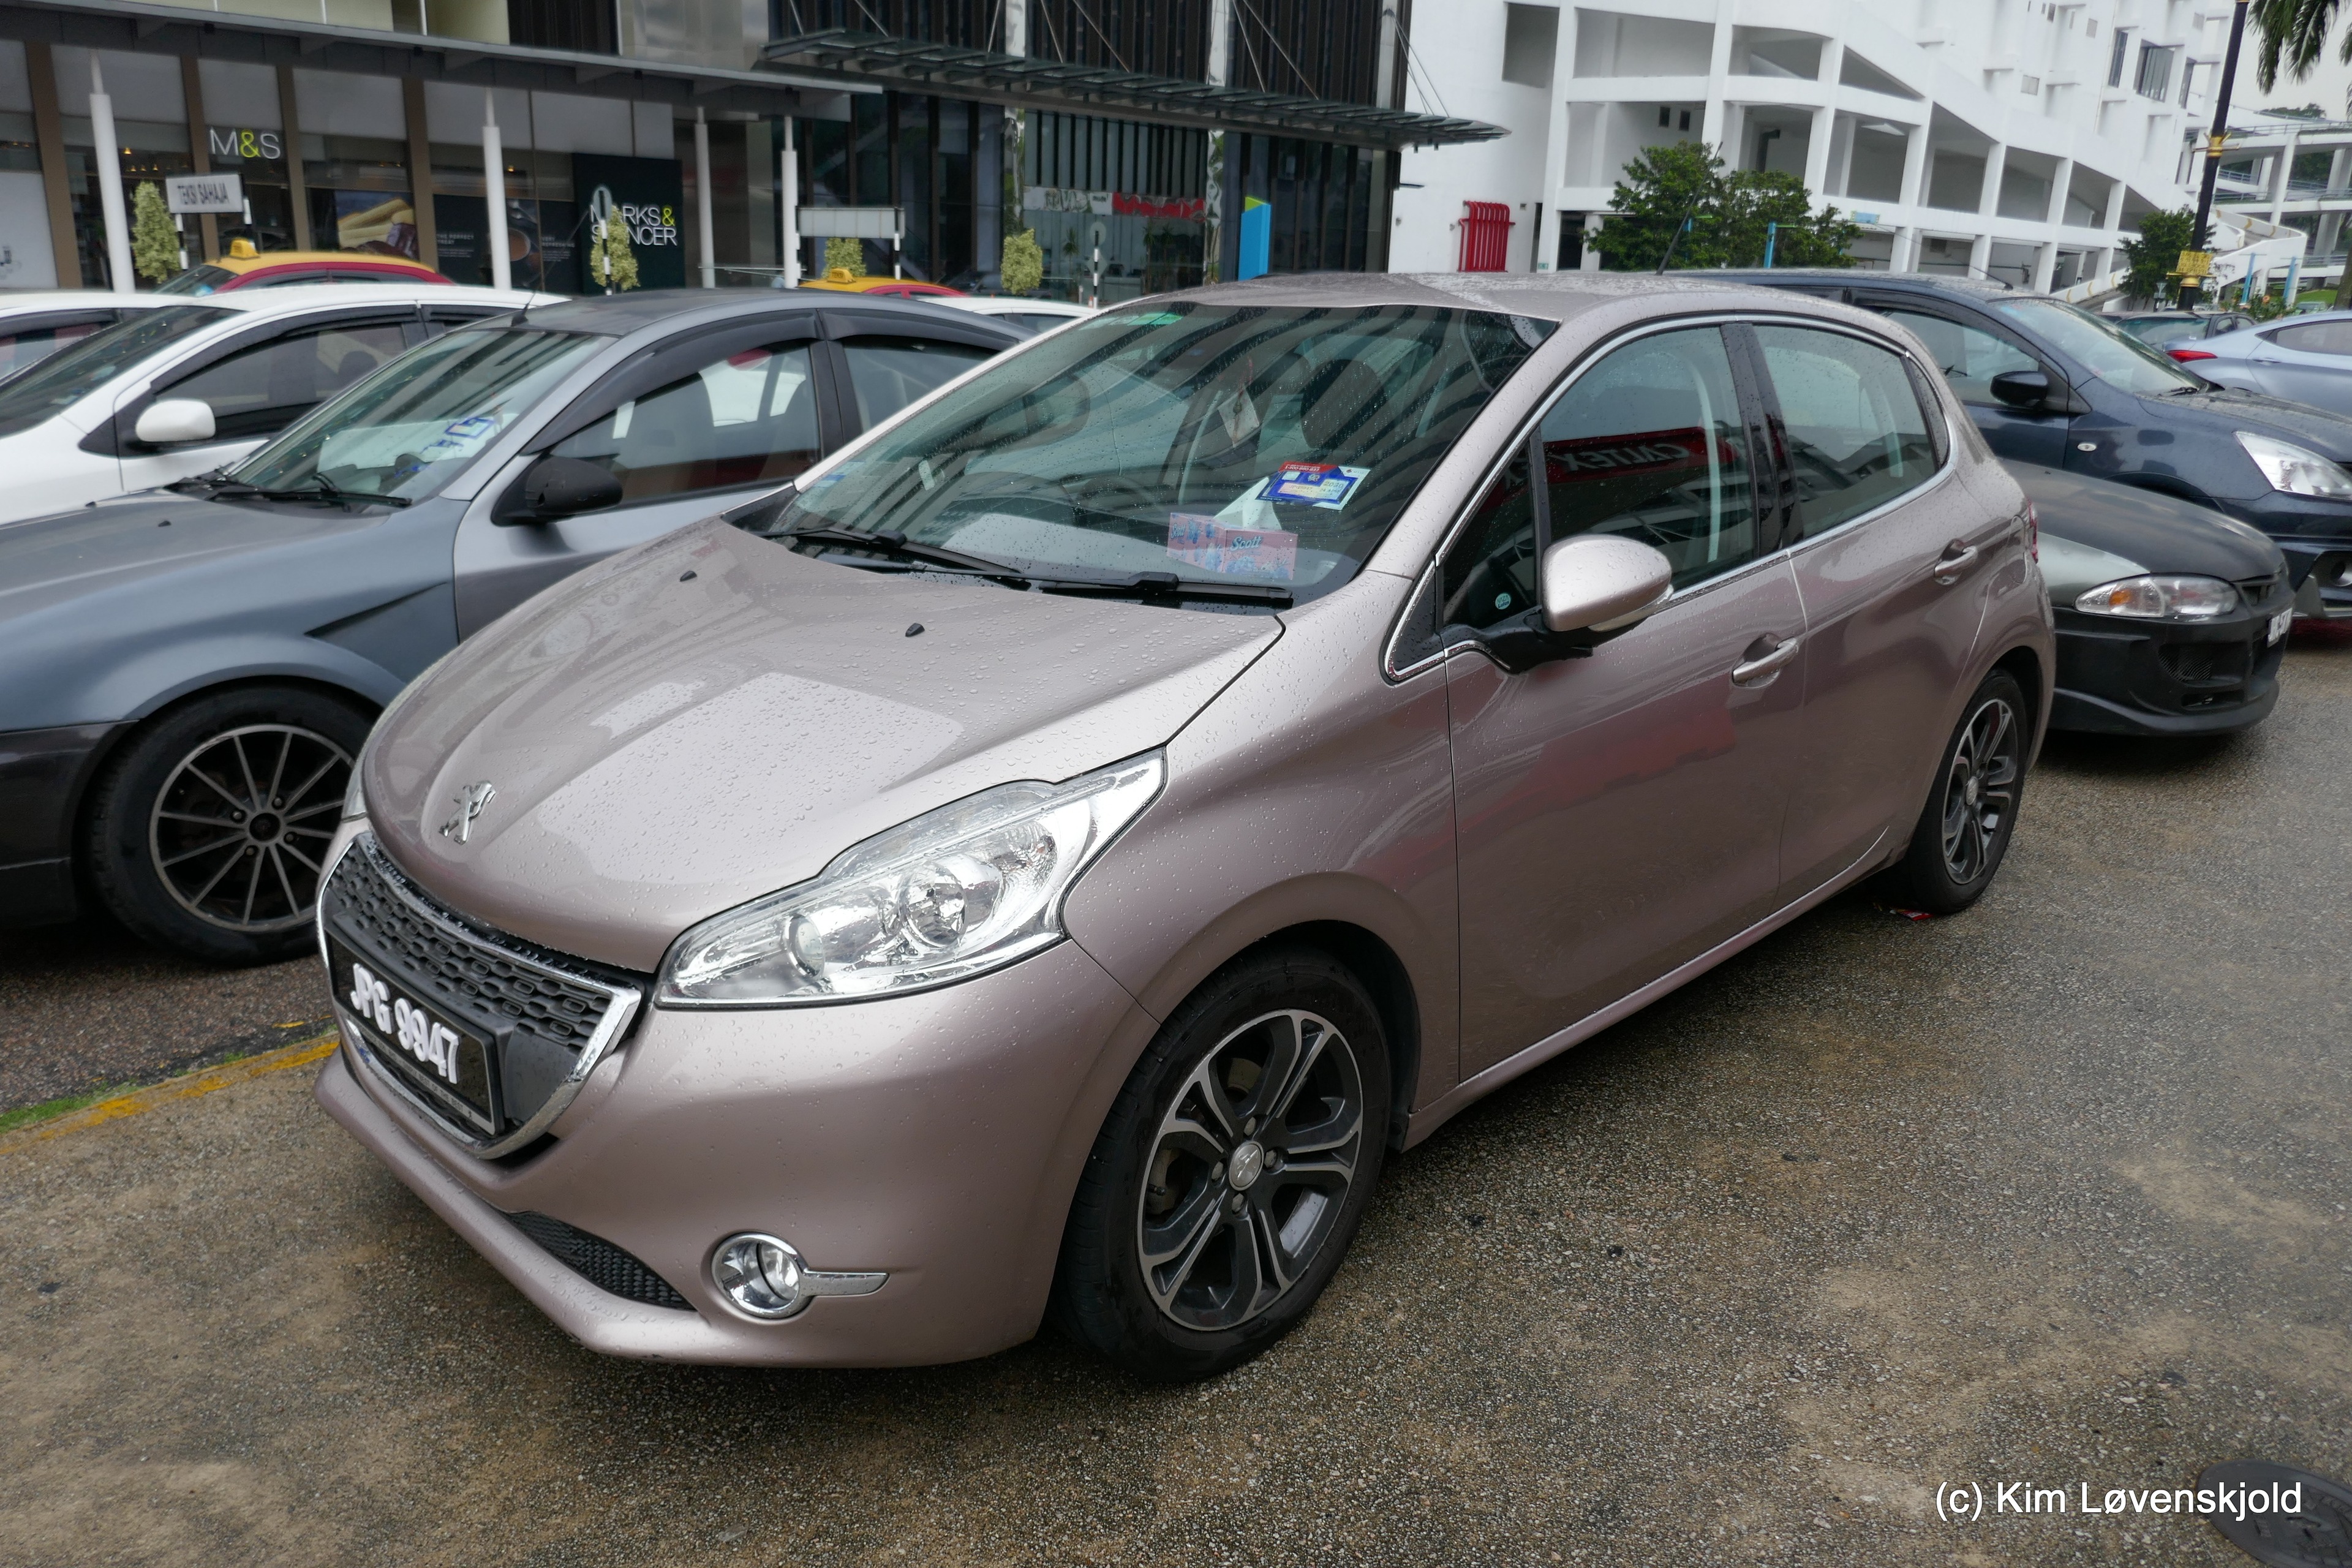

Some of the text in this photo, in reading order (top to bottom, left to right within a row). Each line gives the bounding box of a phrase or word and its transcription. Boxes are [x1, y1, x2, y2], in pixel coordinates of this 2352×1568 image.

[209, 127, 281, 159] M&S
[1170, 524, 1186, 539] Scott
[1230, 535, 1263, 552] Scott
[350, 963, 393, 1035] JPG
[394, 998, 459, 1085] 9947
